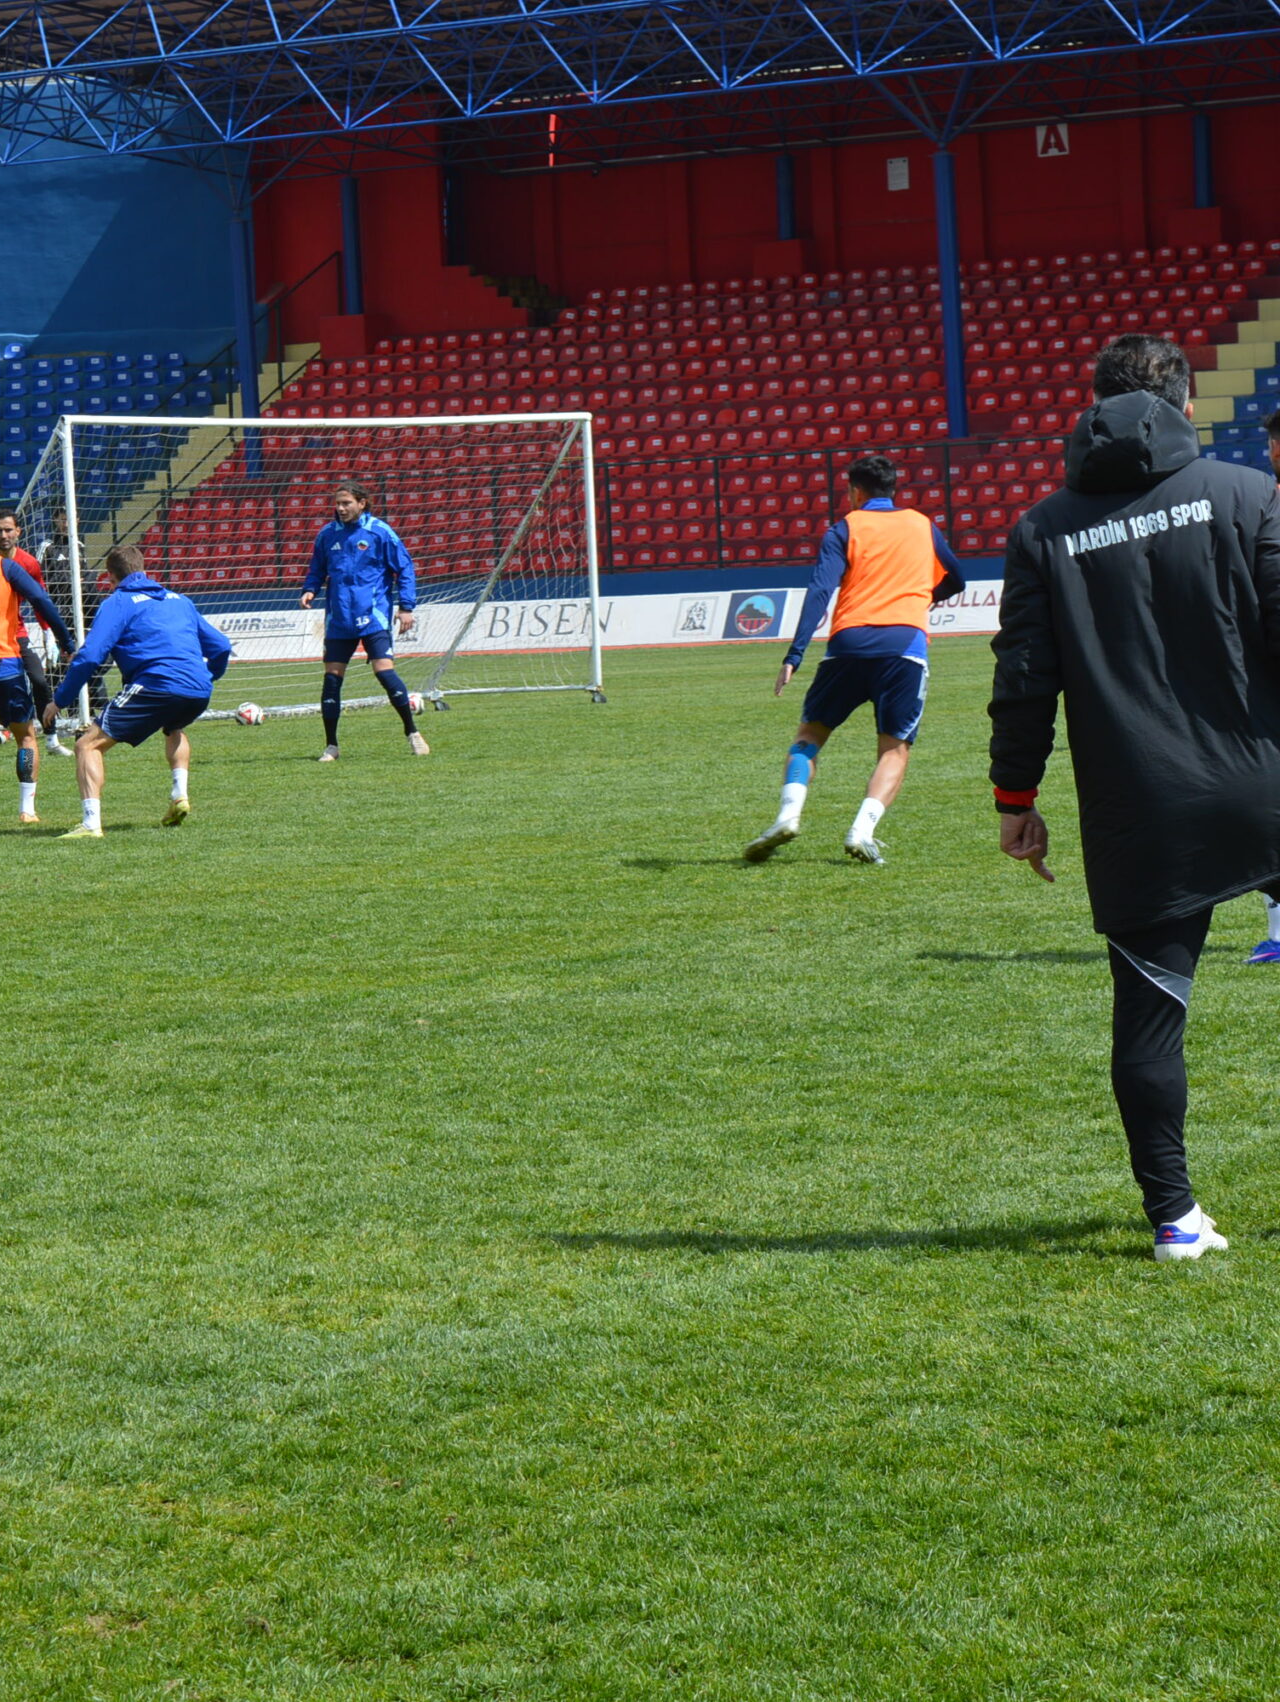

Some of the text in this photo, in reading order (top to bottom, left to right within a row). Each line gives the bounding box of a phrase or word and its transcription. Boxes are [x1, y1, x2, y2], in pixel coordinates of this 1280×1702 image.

[1040, 125, 1068, 155] A
[1128, 509, 1169, 539] 1969
[1170, 499, 1214, 527] SPOR
[220, 617, 262, 632] UMR
